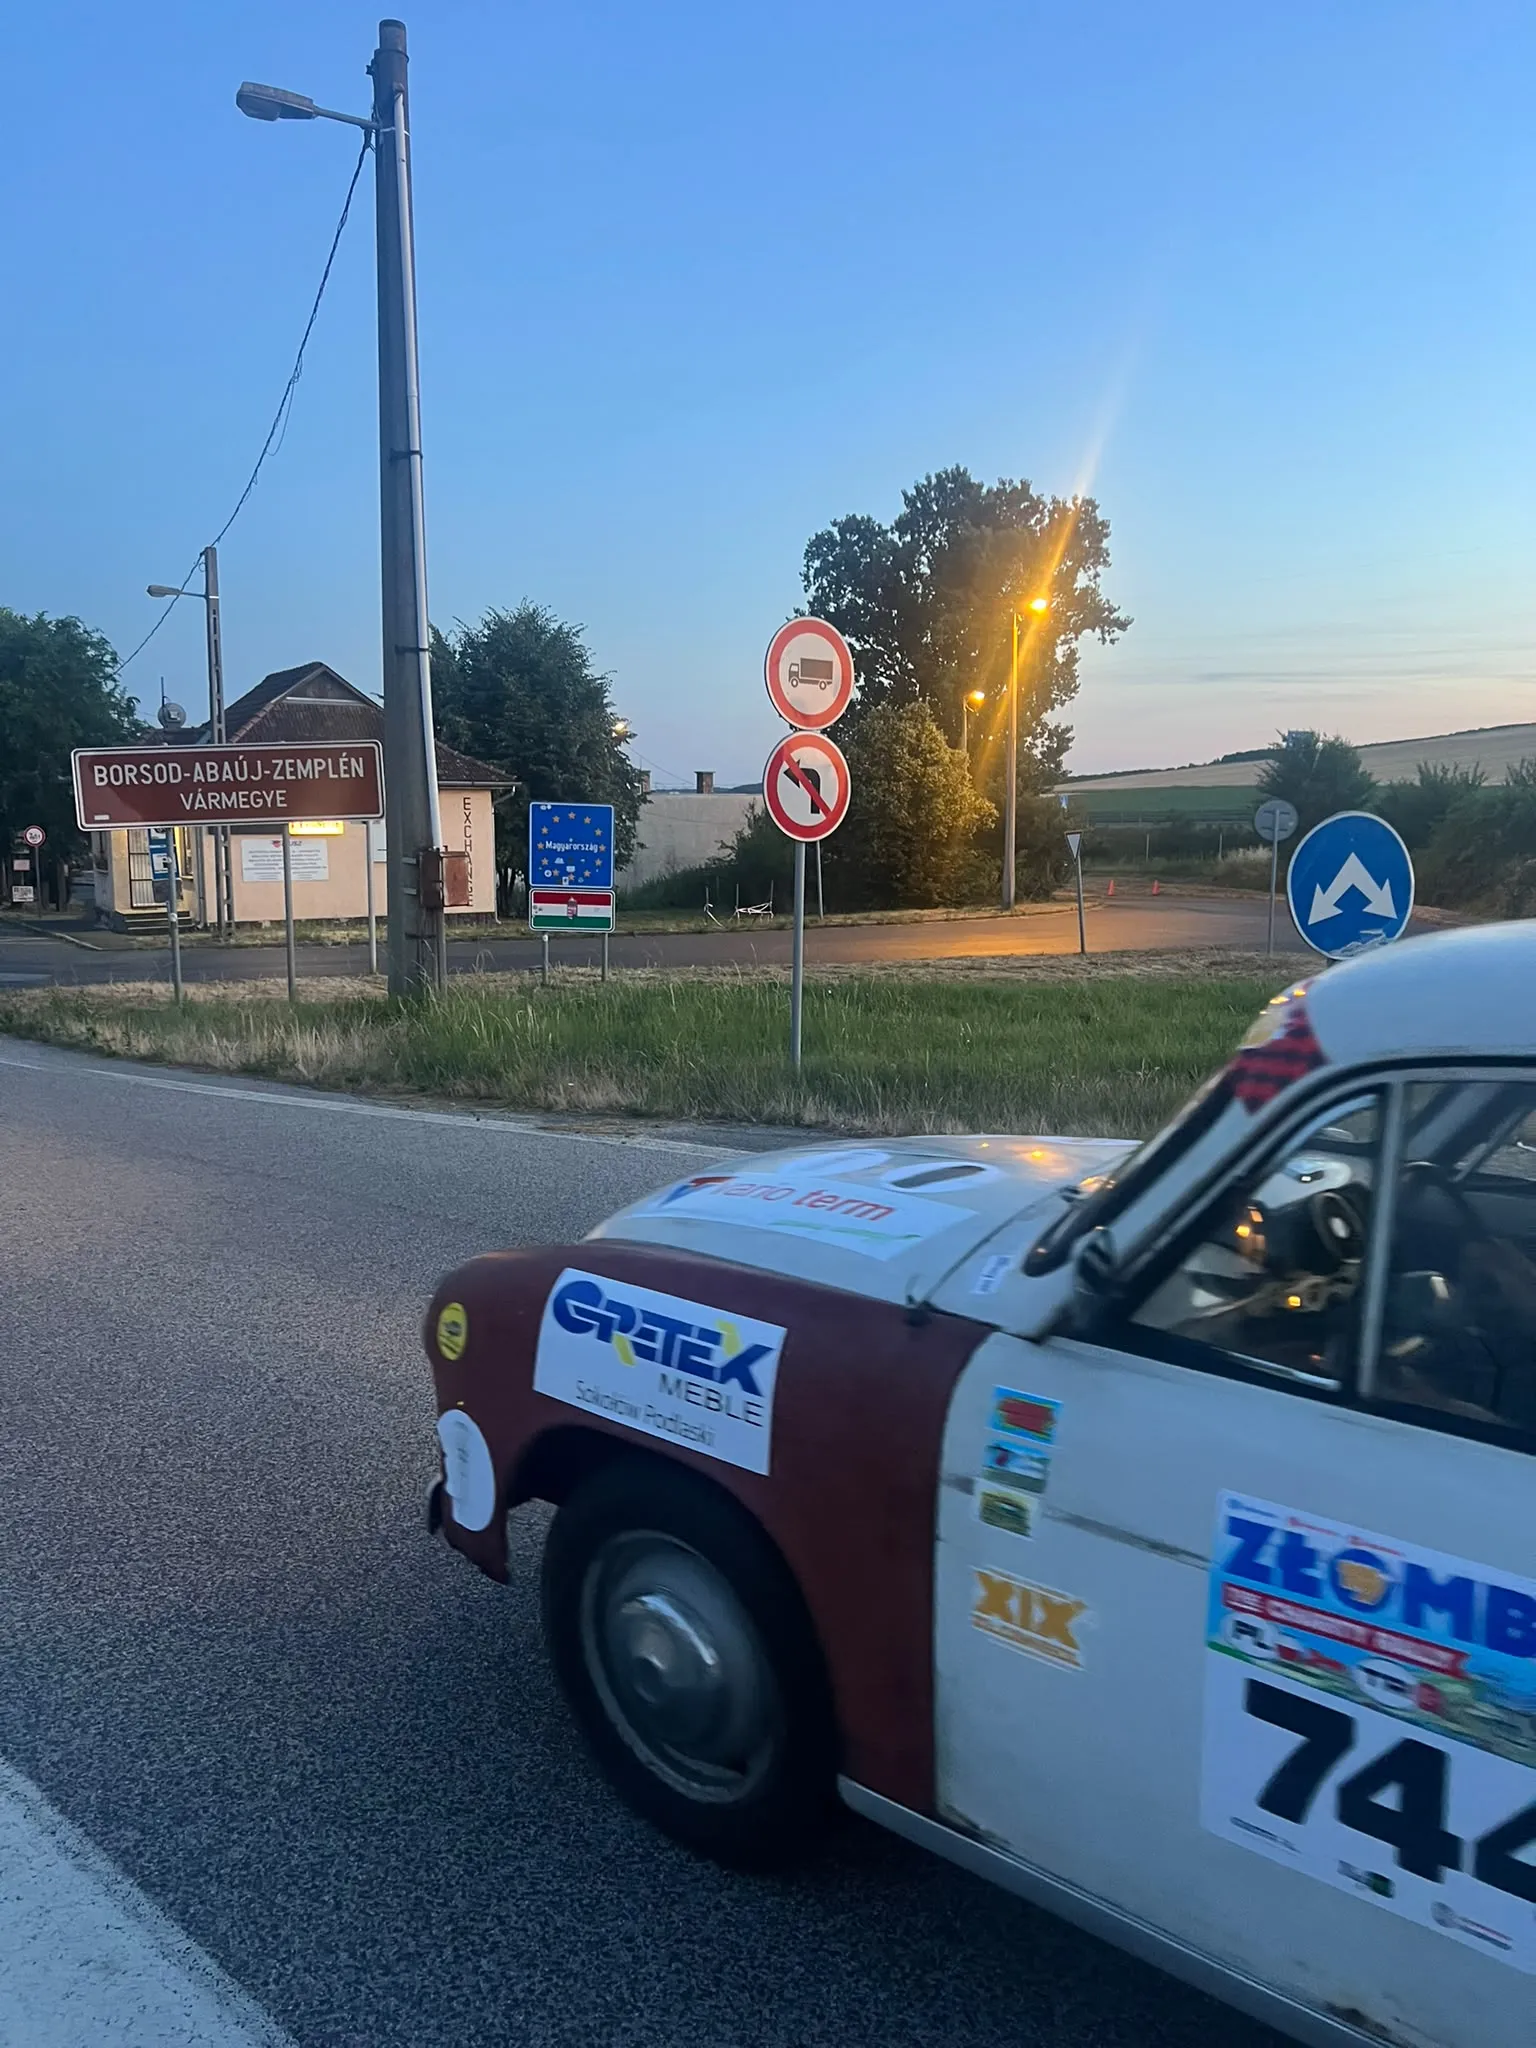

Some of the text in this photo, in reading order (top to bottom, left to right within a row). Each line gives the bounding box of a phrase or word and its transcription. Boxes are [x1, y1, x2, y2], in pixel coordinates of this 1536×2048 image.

[93, 752, 365, 787] BORSOD-ABAÚJ-ZEMPLÉN
[180, 788, 288, 811] VÁRMEGYE
[545, 839, 599, 853] Magyarország
[791, 1189, 896, 1222] term
[553, 1280, 774, 1397] GRETEX
[658, 1372, 765, 1428] MEBLE
